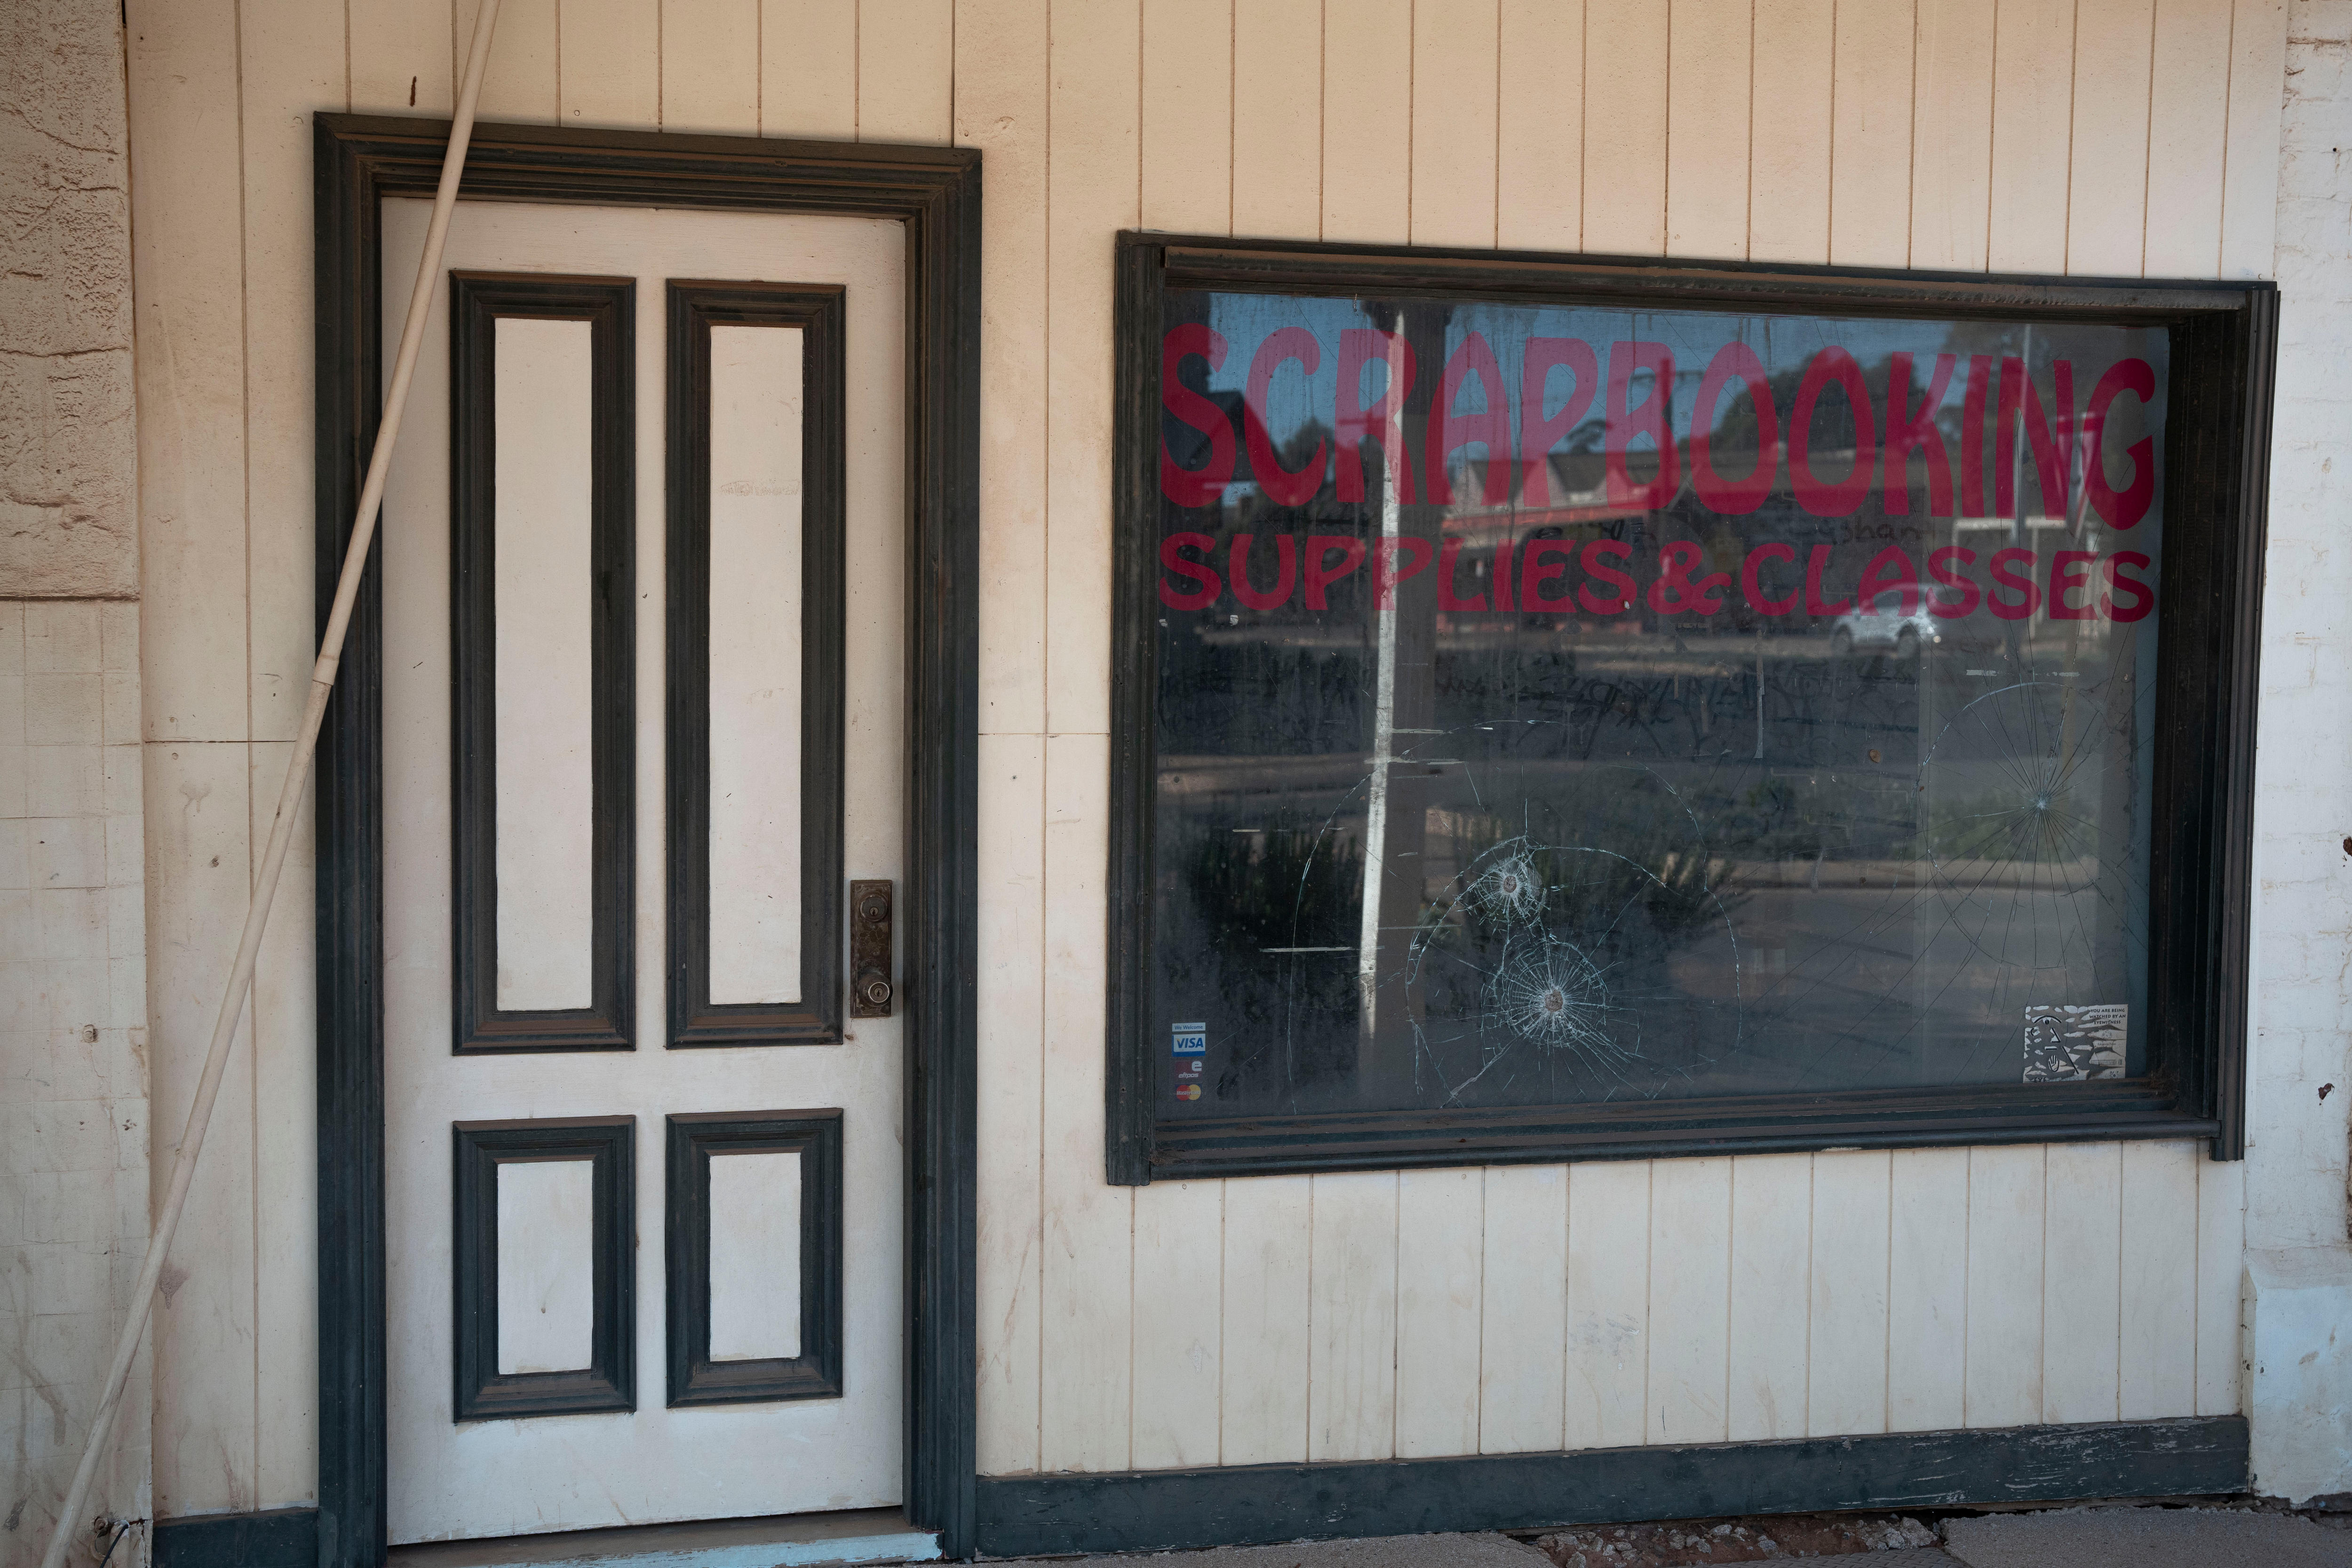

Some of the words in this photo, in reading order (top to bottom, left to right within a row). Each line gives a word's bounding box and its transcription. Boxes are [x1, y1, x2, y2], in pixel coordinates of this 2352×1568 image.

[1160, 323, 2156, 530] SCRAPBOOKING
[1160, 532, 1637, 614] SUPPLIES
[1647, 541, 1732, 615] &
[1742, 542, 2154, 622] CLASSES
[1176, 1037, 1204, 1048] VISA
